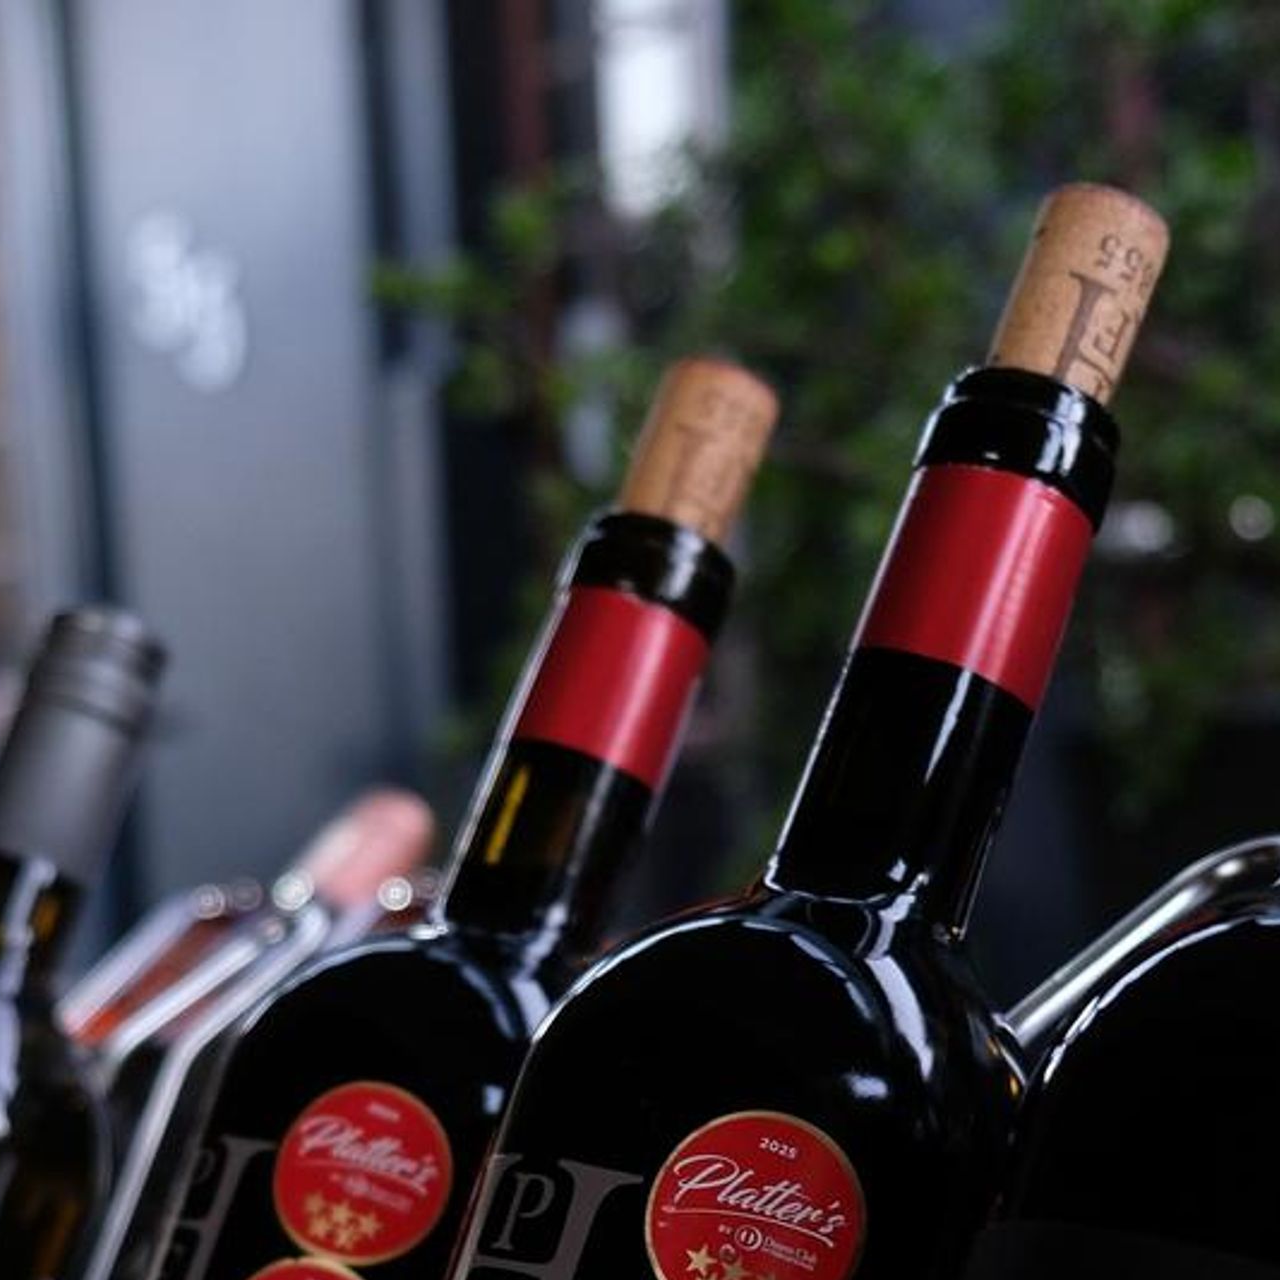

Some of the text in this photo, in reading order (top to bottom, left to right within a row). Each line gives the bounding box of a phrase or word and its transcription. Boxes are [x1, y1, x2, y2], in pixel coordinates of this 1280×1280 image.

[758, 1136, 799, 1160] 2025
[489, 1168, 557, 1252] P
[673, 1153, 847, 1236] Platter's
